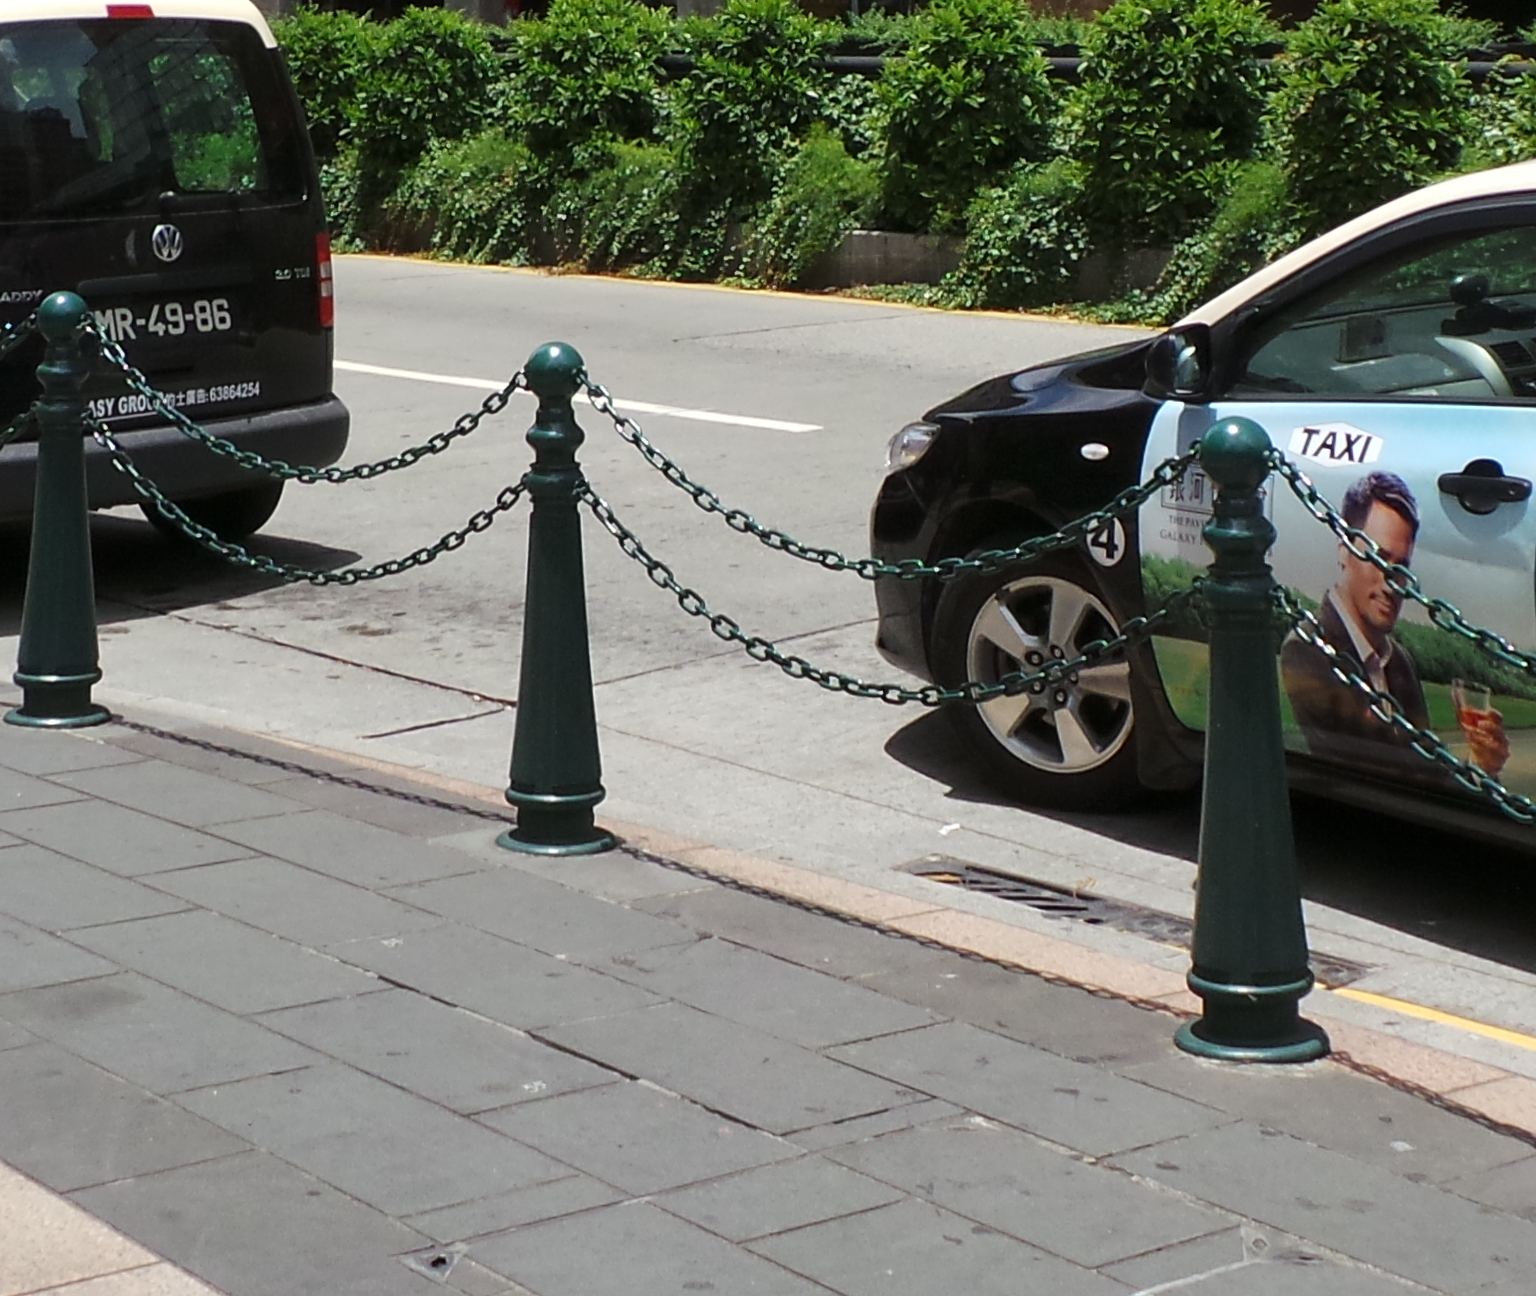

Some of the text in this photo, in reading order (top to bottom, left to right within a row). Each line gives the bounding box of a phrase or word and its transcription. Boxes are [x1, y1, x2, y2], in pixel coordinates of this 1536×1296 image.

[94, 299, 232, 341] MR-49-86
[88, 396, 115, 418] ASY
[1301, 428, 1373, 464] TAXI
